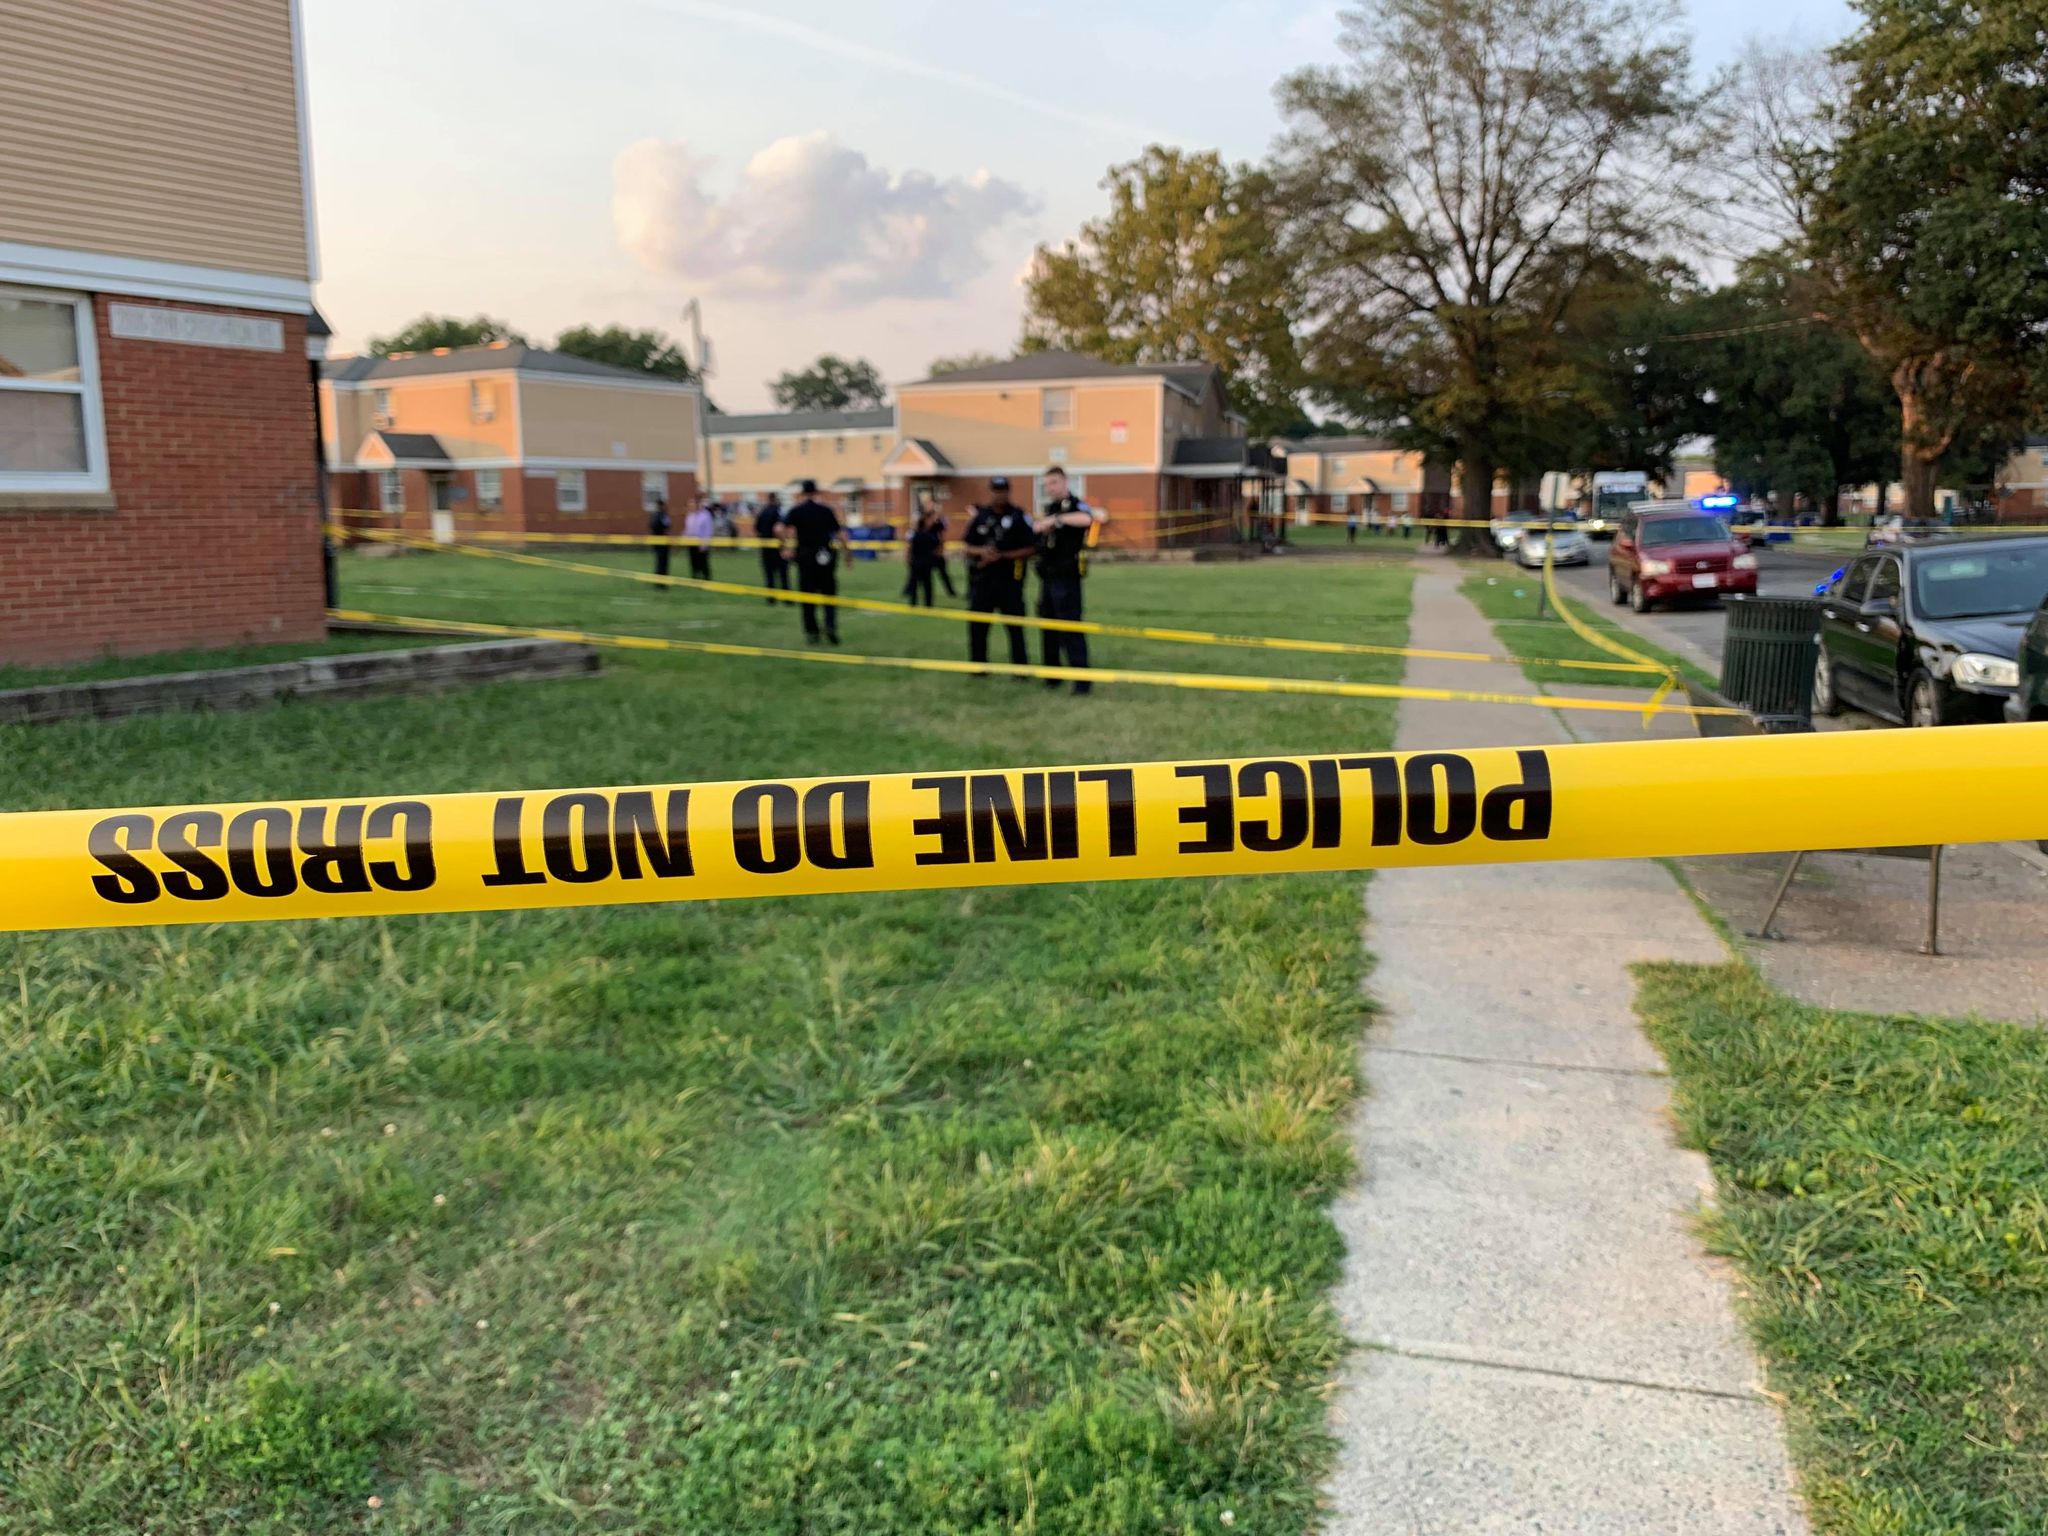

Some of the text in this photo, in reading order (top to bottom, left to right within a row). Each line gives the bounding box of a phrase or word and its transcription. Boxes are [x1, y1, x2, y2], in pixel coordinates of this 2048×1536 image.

[88, 749, 1553, 904] POLICE LINE DO NOT CROSS
